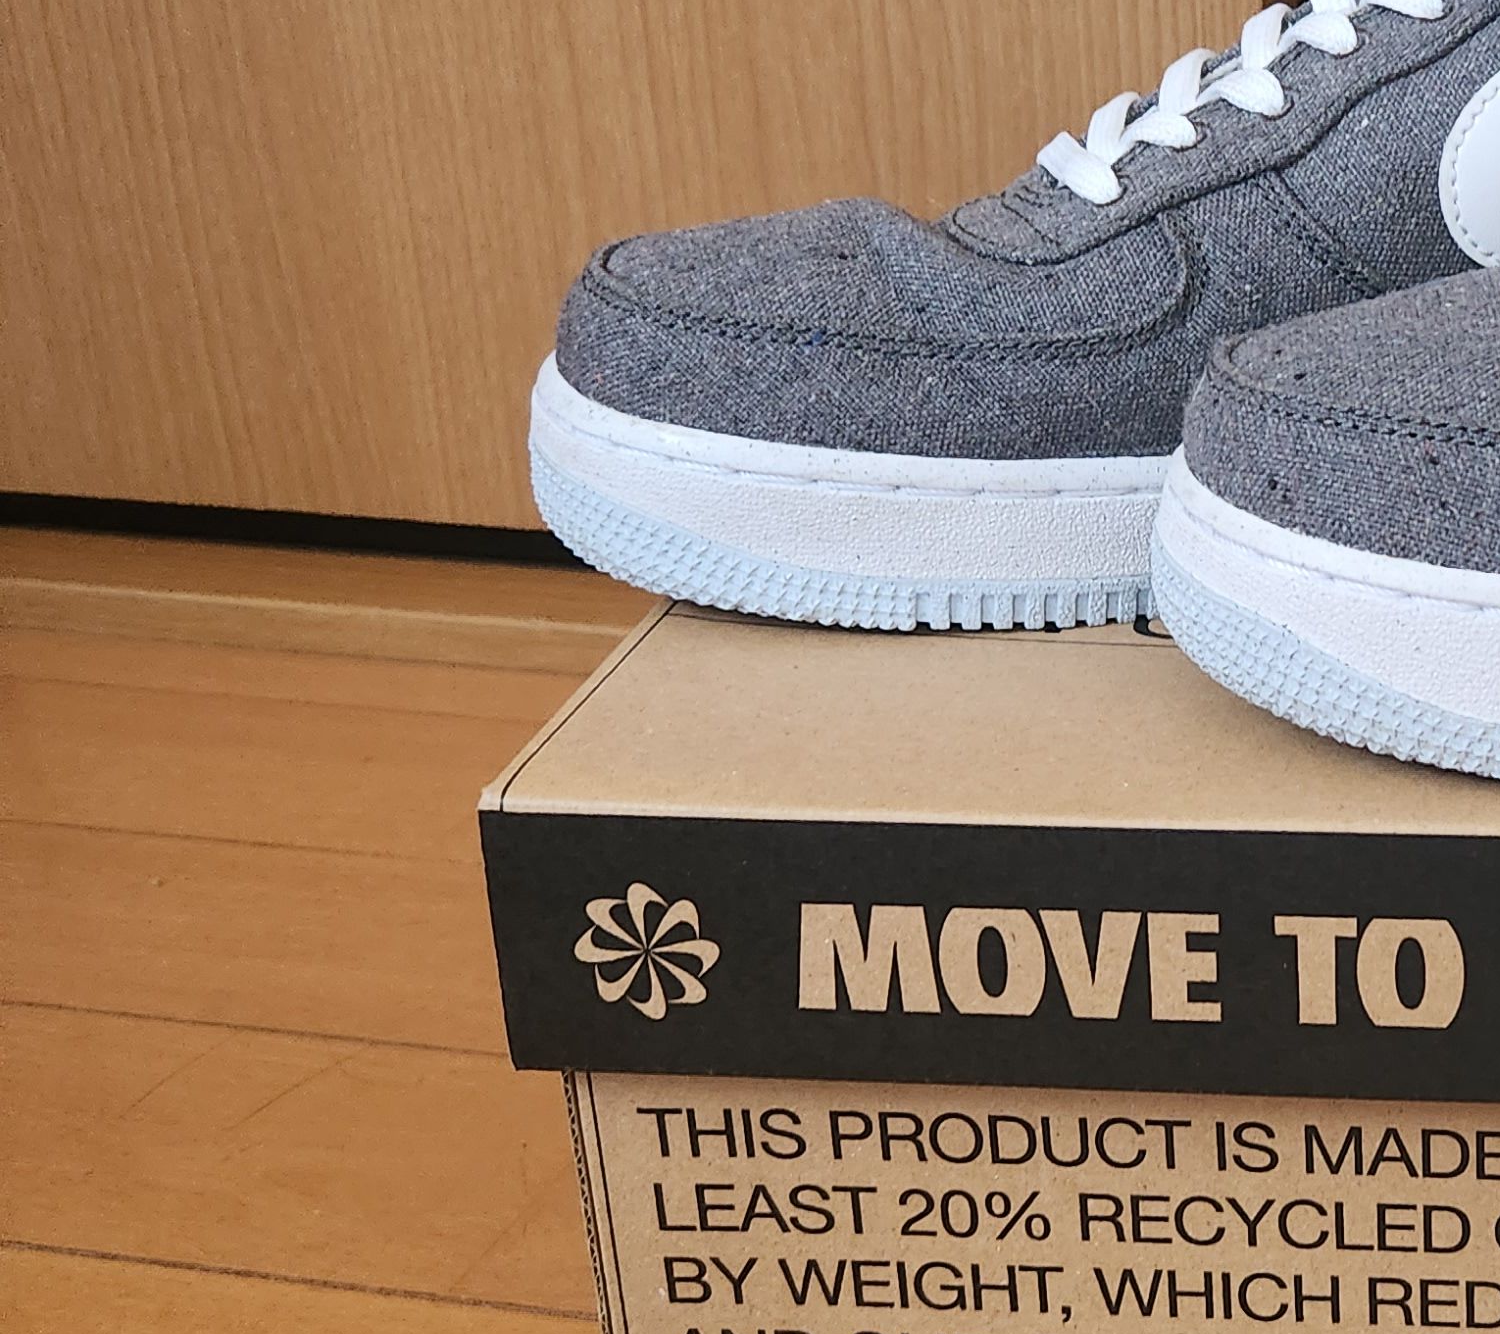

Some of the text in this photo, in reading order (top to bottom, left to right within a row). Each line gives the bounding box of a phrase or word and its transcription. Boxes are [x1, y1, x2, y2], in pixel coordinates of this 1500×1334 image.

[799, 902, 1222, 1022] MOVE
[1273, 915, 1466, 1030] TO
[636, 1106, 807, 1160] THIS
[829, 1111, 1192, 1169] PRODUCT
[1214, 1121, 1279, 1173] IS
[652, 1183, 878, 1235] LEAST
[898, 1188, 1052, 1242] 20%
[1078, 1192, 1472, 1254] RECYCLED
[662, 1257, 758, 1305] BY
[777, 1258, 1073, 1323] WEIGHT,
[1093, 1266, 1341, 1325] WHICH
